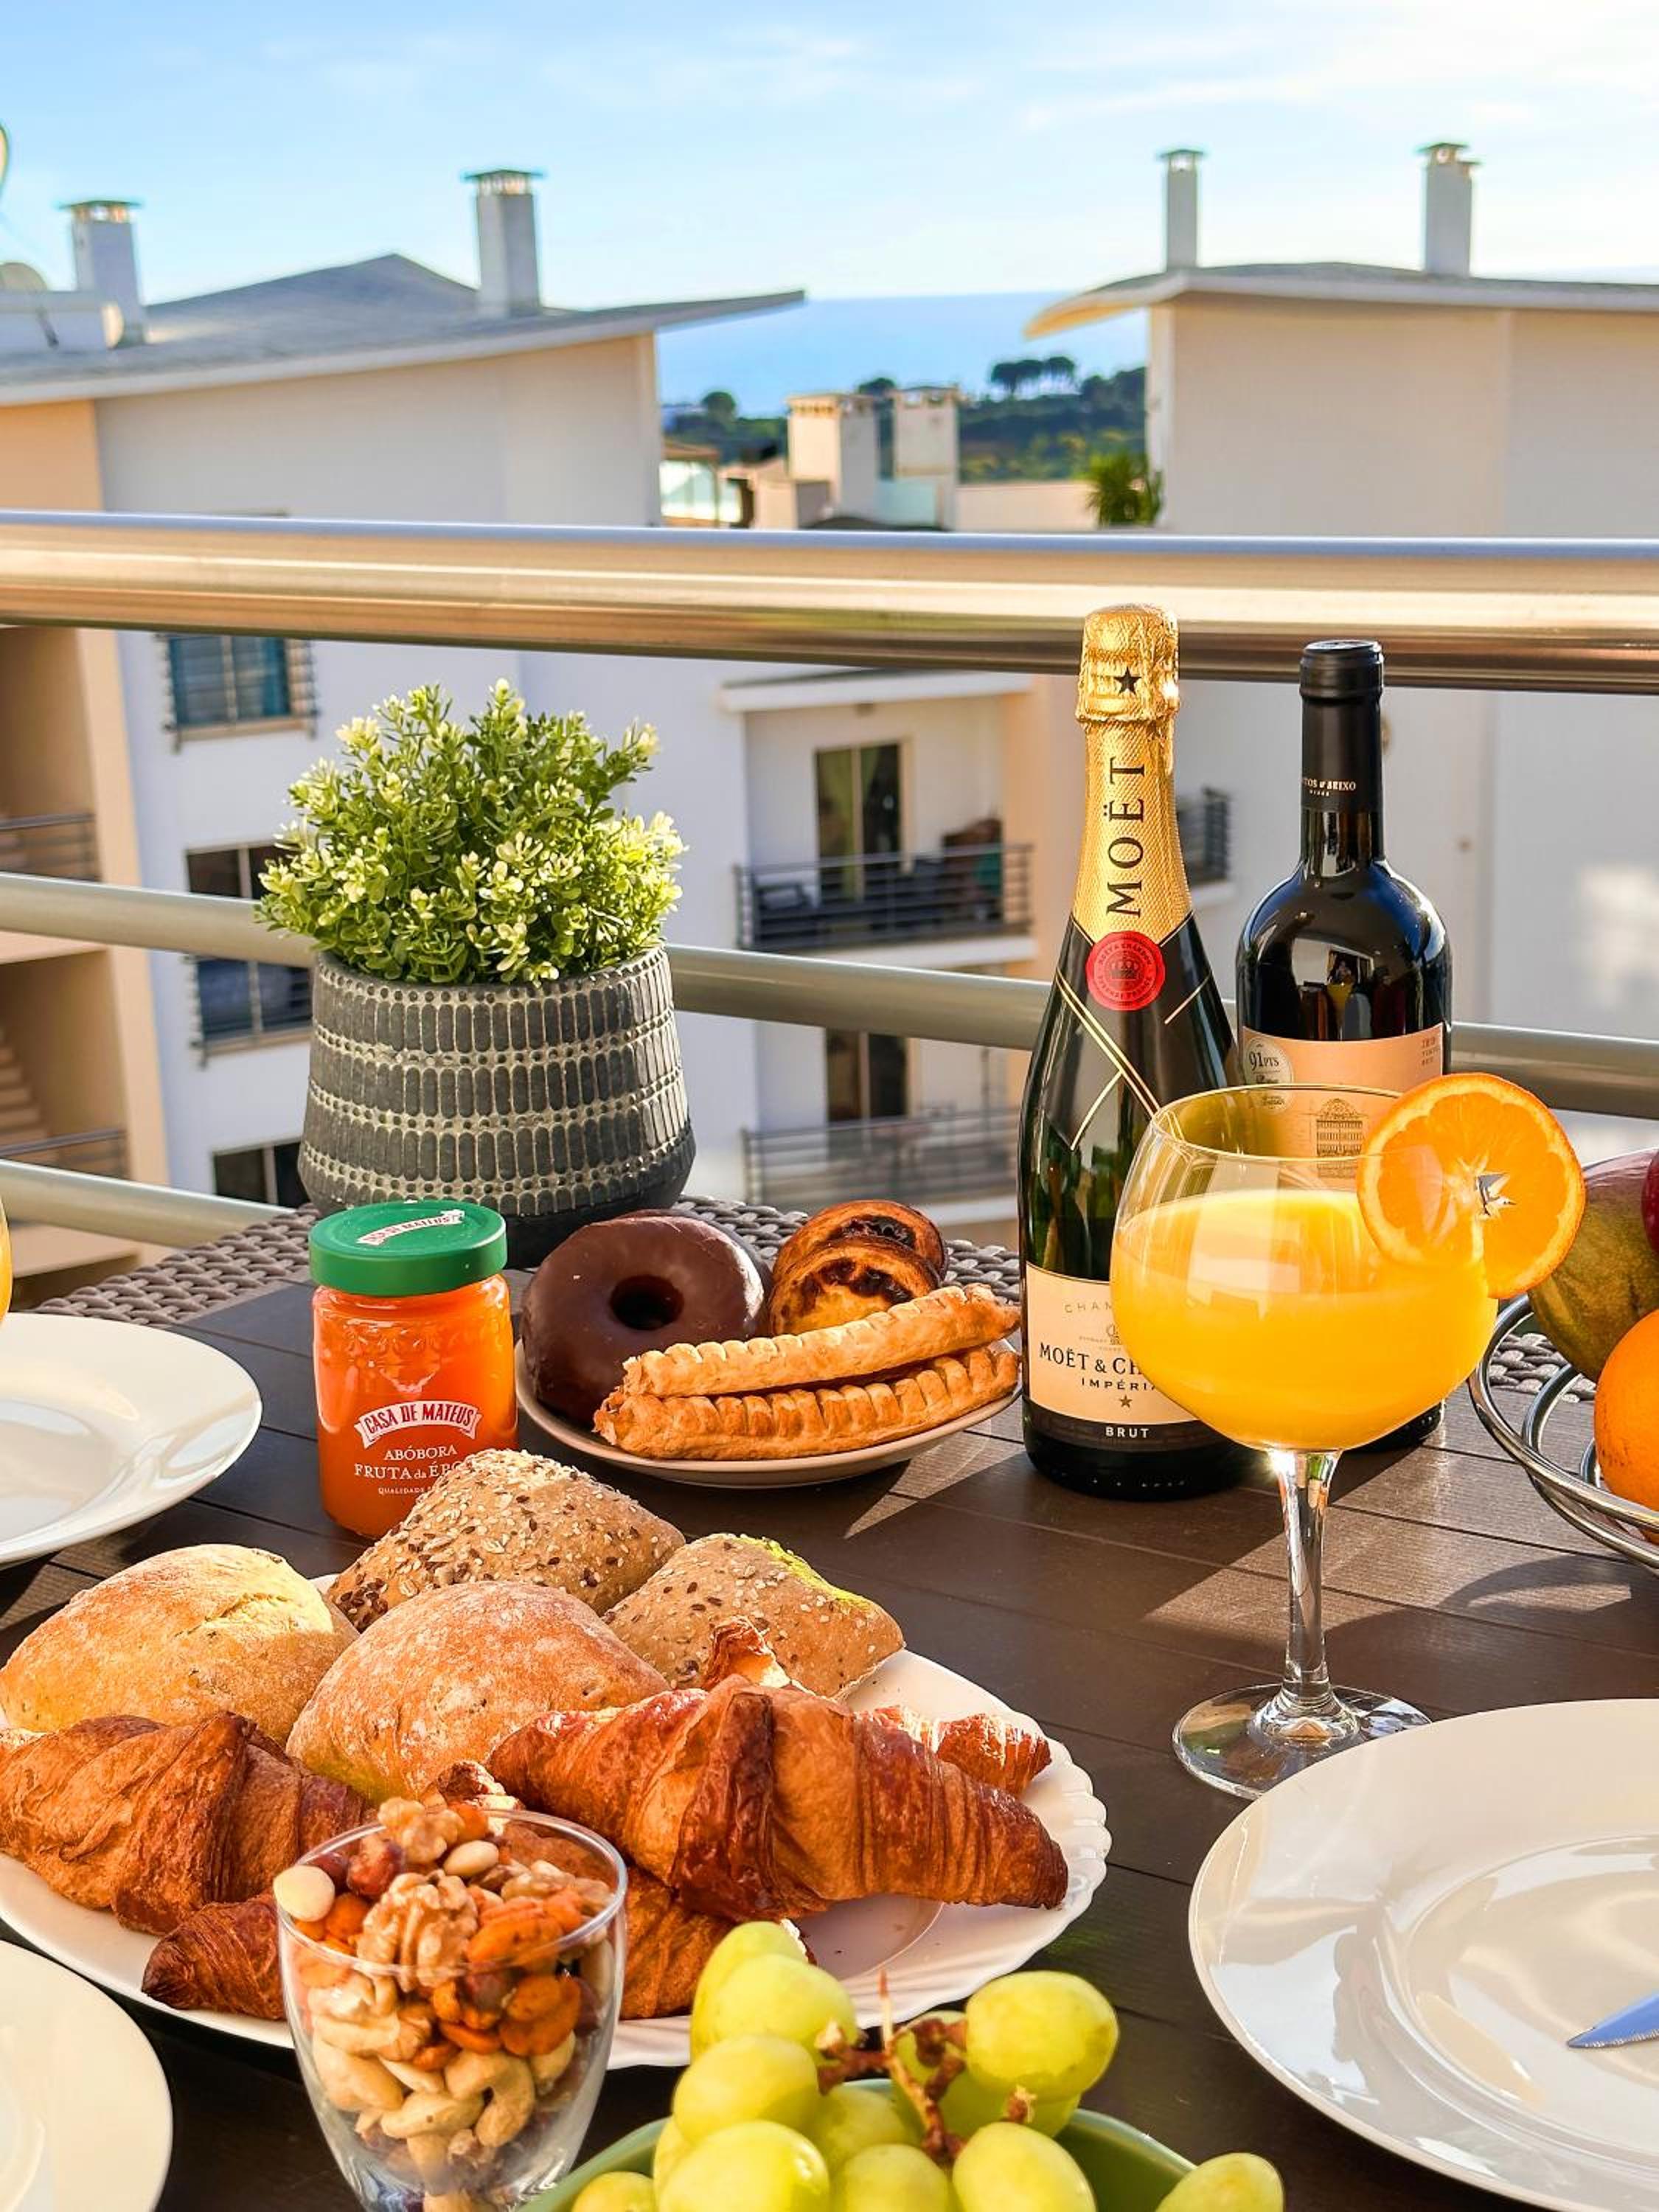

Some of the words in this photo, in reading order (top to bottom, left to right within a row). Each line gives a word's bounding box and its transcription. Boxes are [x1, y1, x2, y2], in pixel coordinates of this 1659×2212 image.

[1103, 757, 1145, 918] MOËT
[1040, 1342, 1090, 1371] MOËT
[1094, 1359, 1107, 1374] &
[1082, 1377, 1155, 1391] IMPÉRI
[364, 1408, 398, 1434] CASA
[400, 1403, 418, 1422] DE
[422, 1403, 474, 1427] MATEUS
[1105, 1427, 1150, 1439] BRUT
[384, 1444, 458, 1461] ABÓBORA
[354, 1463, 412, 1480] FRUTA
[414, 1470, 427, 1479] da
